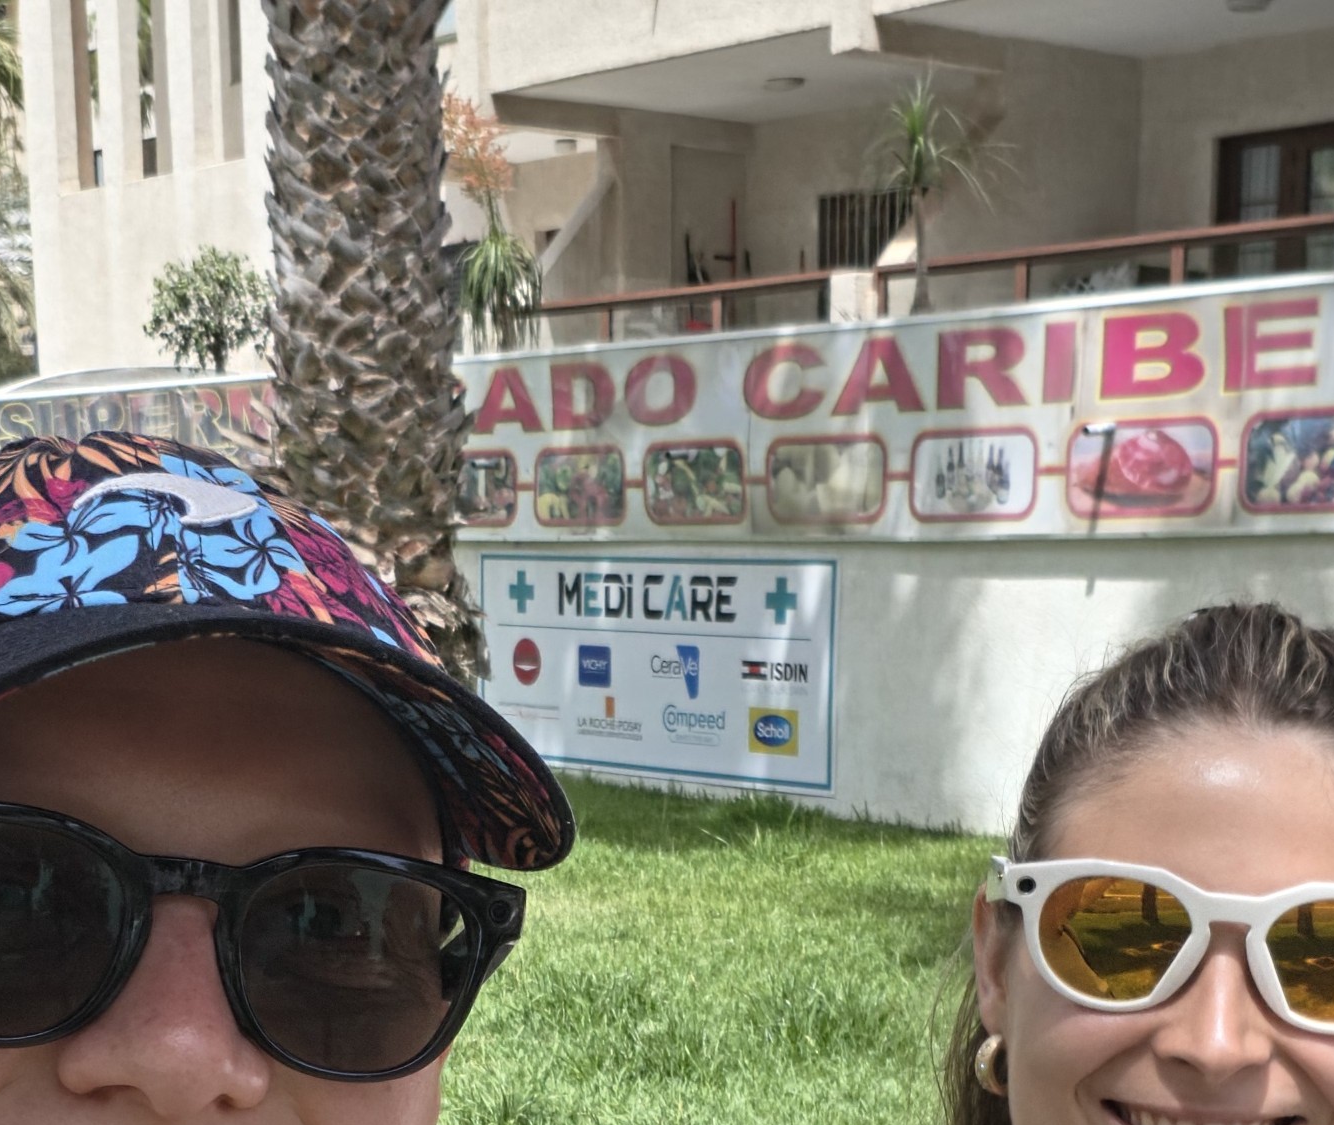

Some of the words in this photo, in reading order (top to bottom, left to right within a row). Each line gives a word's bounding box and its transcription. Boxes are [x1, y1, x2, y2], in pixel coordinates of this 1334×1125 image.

[743, 297, 1320, 420] CARIBE
[582, 659, 608, 671] VICHY
[650, 654, 699, 677] CeraVe
[770, 662, 809, 683] ISDIN
[577, 717, 588, 728] LA
[662, 704, 727, 734] Compeed
[756, 721, 790, 740] Scholl
